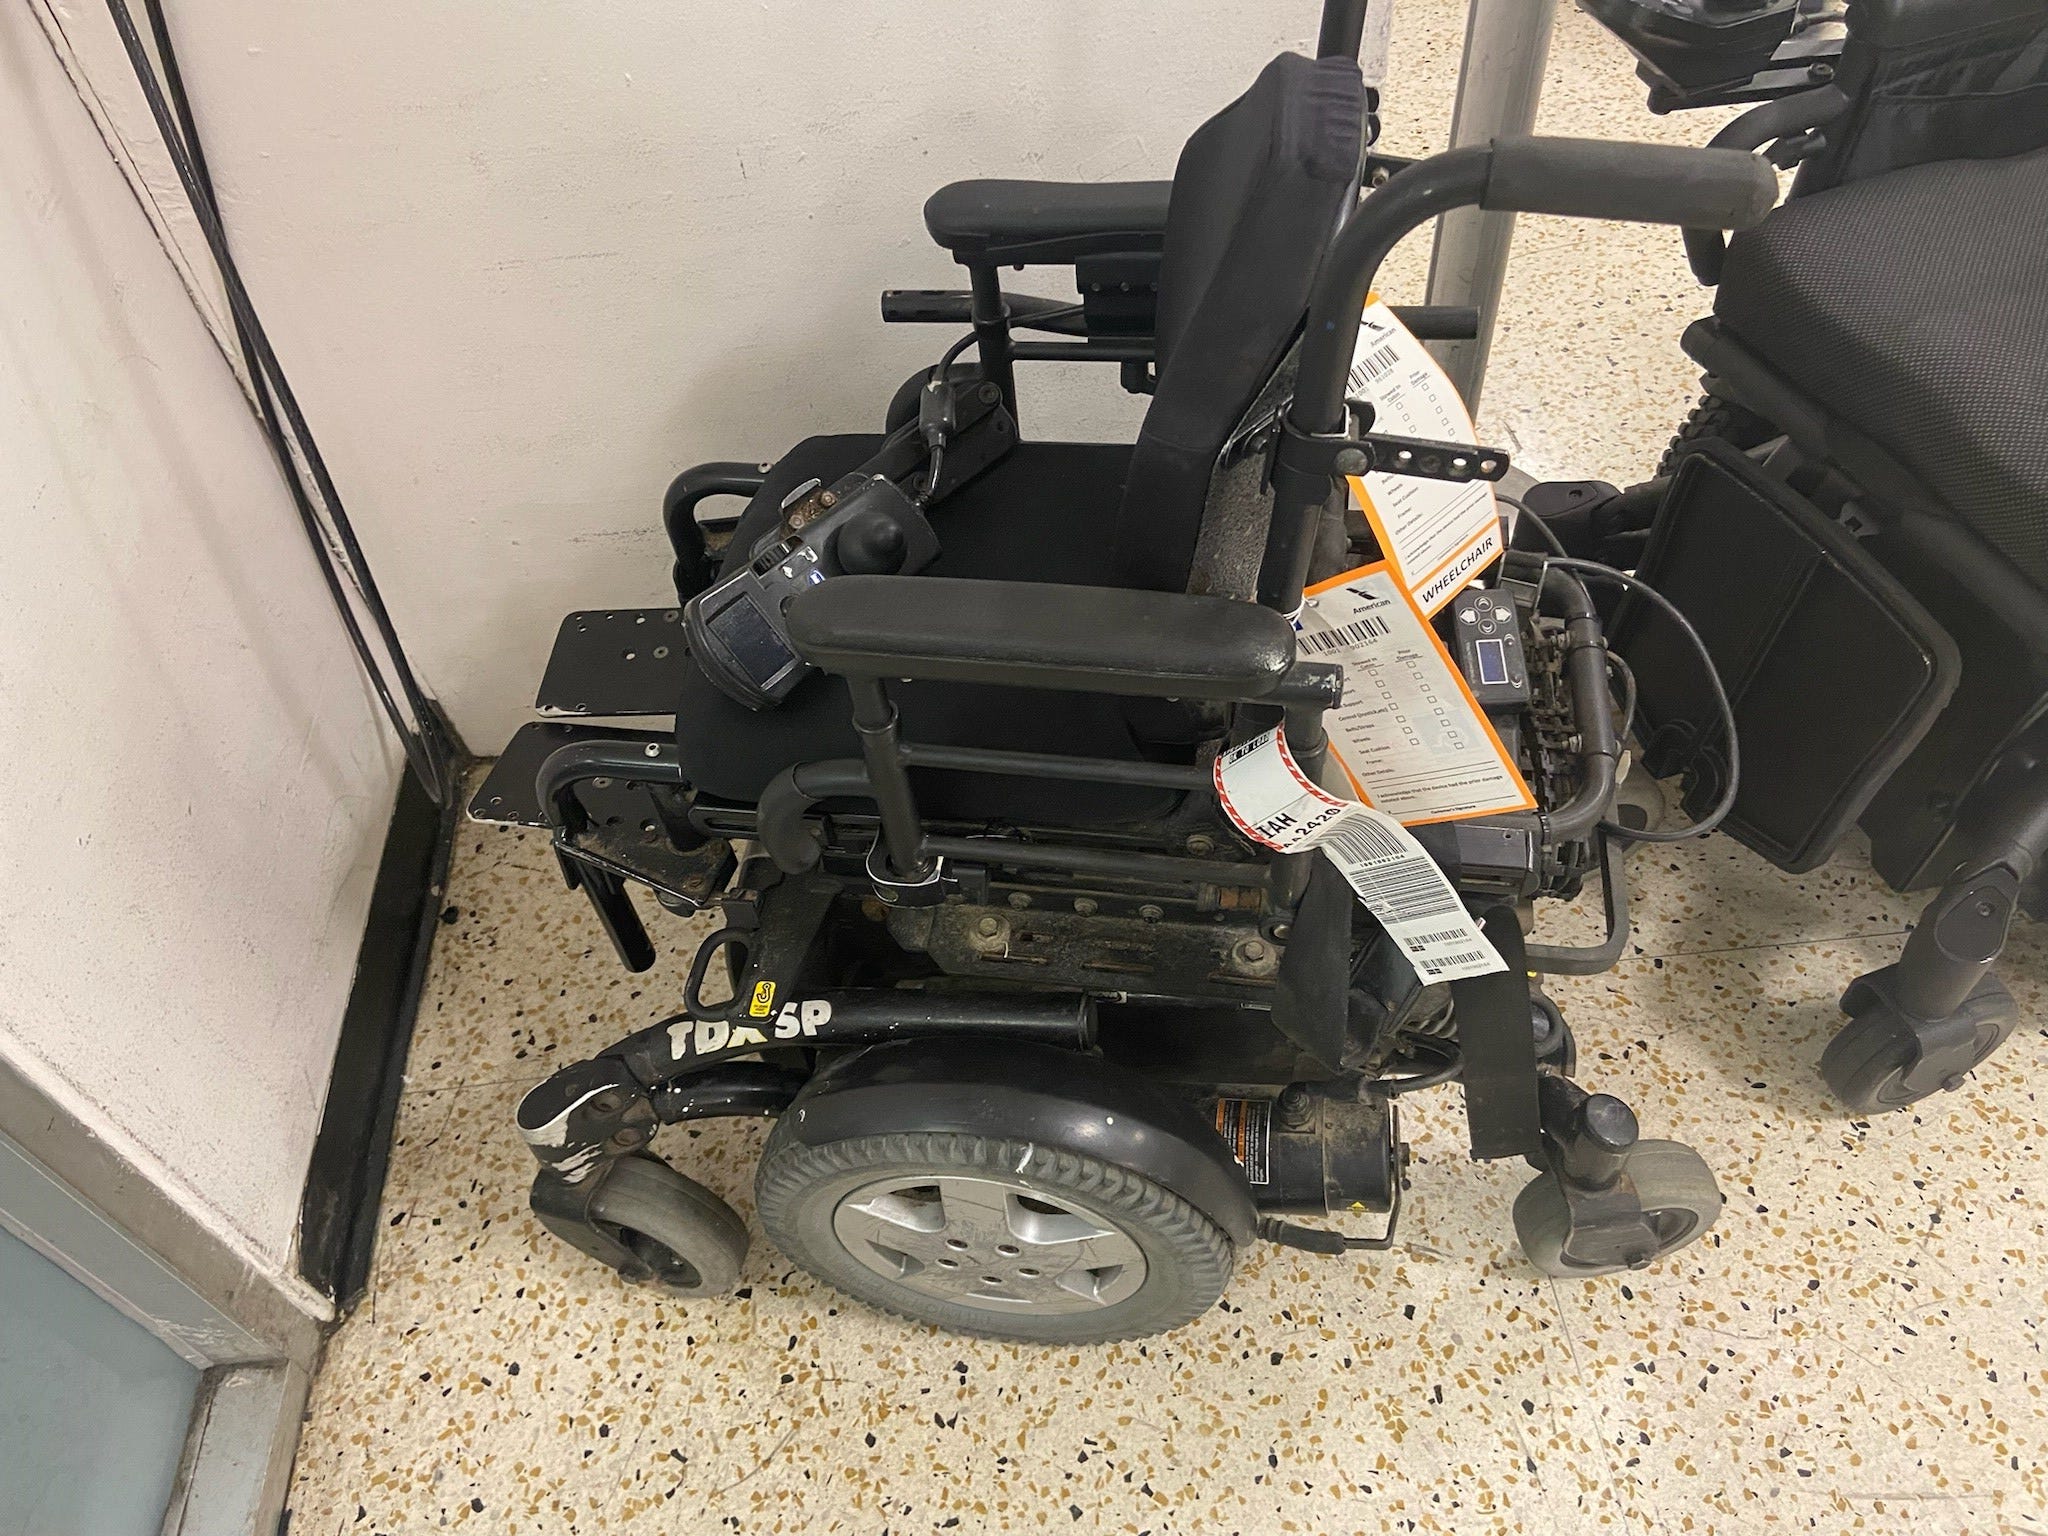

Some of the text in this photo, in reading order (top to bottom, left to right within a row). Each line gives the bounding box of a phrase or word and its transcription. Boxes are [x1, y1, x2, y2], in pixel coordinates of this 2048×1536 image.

[1421, 536, 1494, 601] WHEELCHAIR
[1352, 599, 1391, 614] American
[1255, 811, 1298, 839] IAH
[775, 1000, 832, 1039] SP
